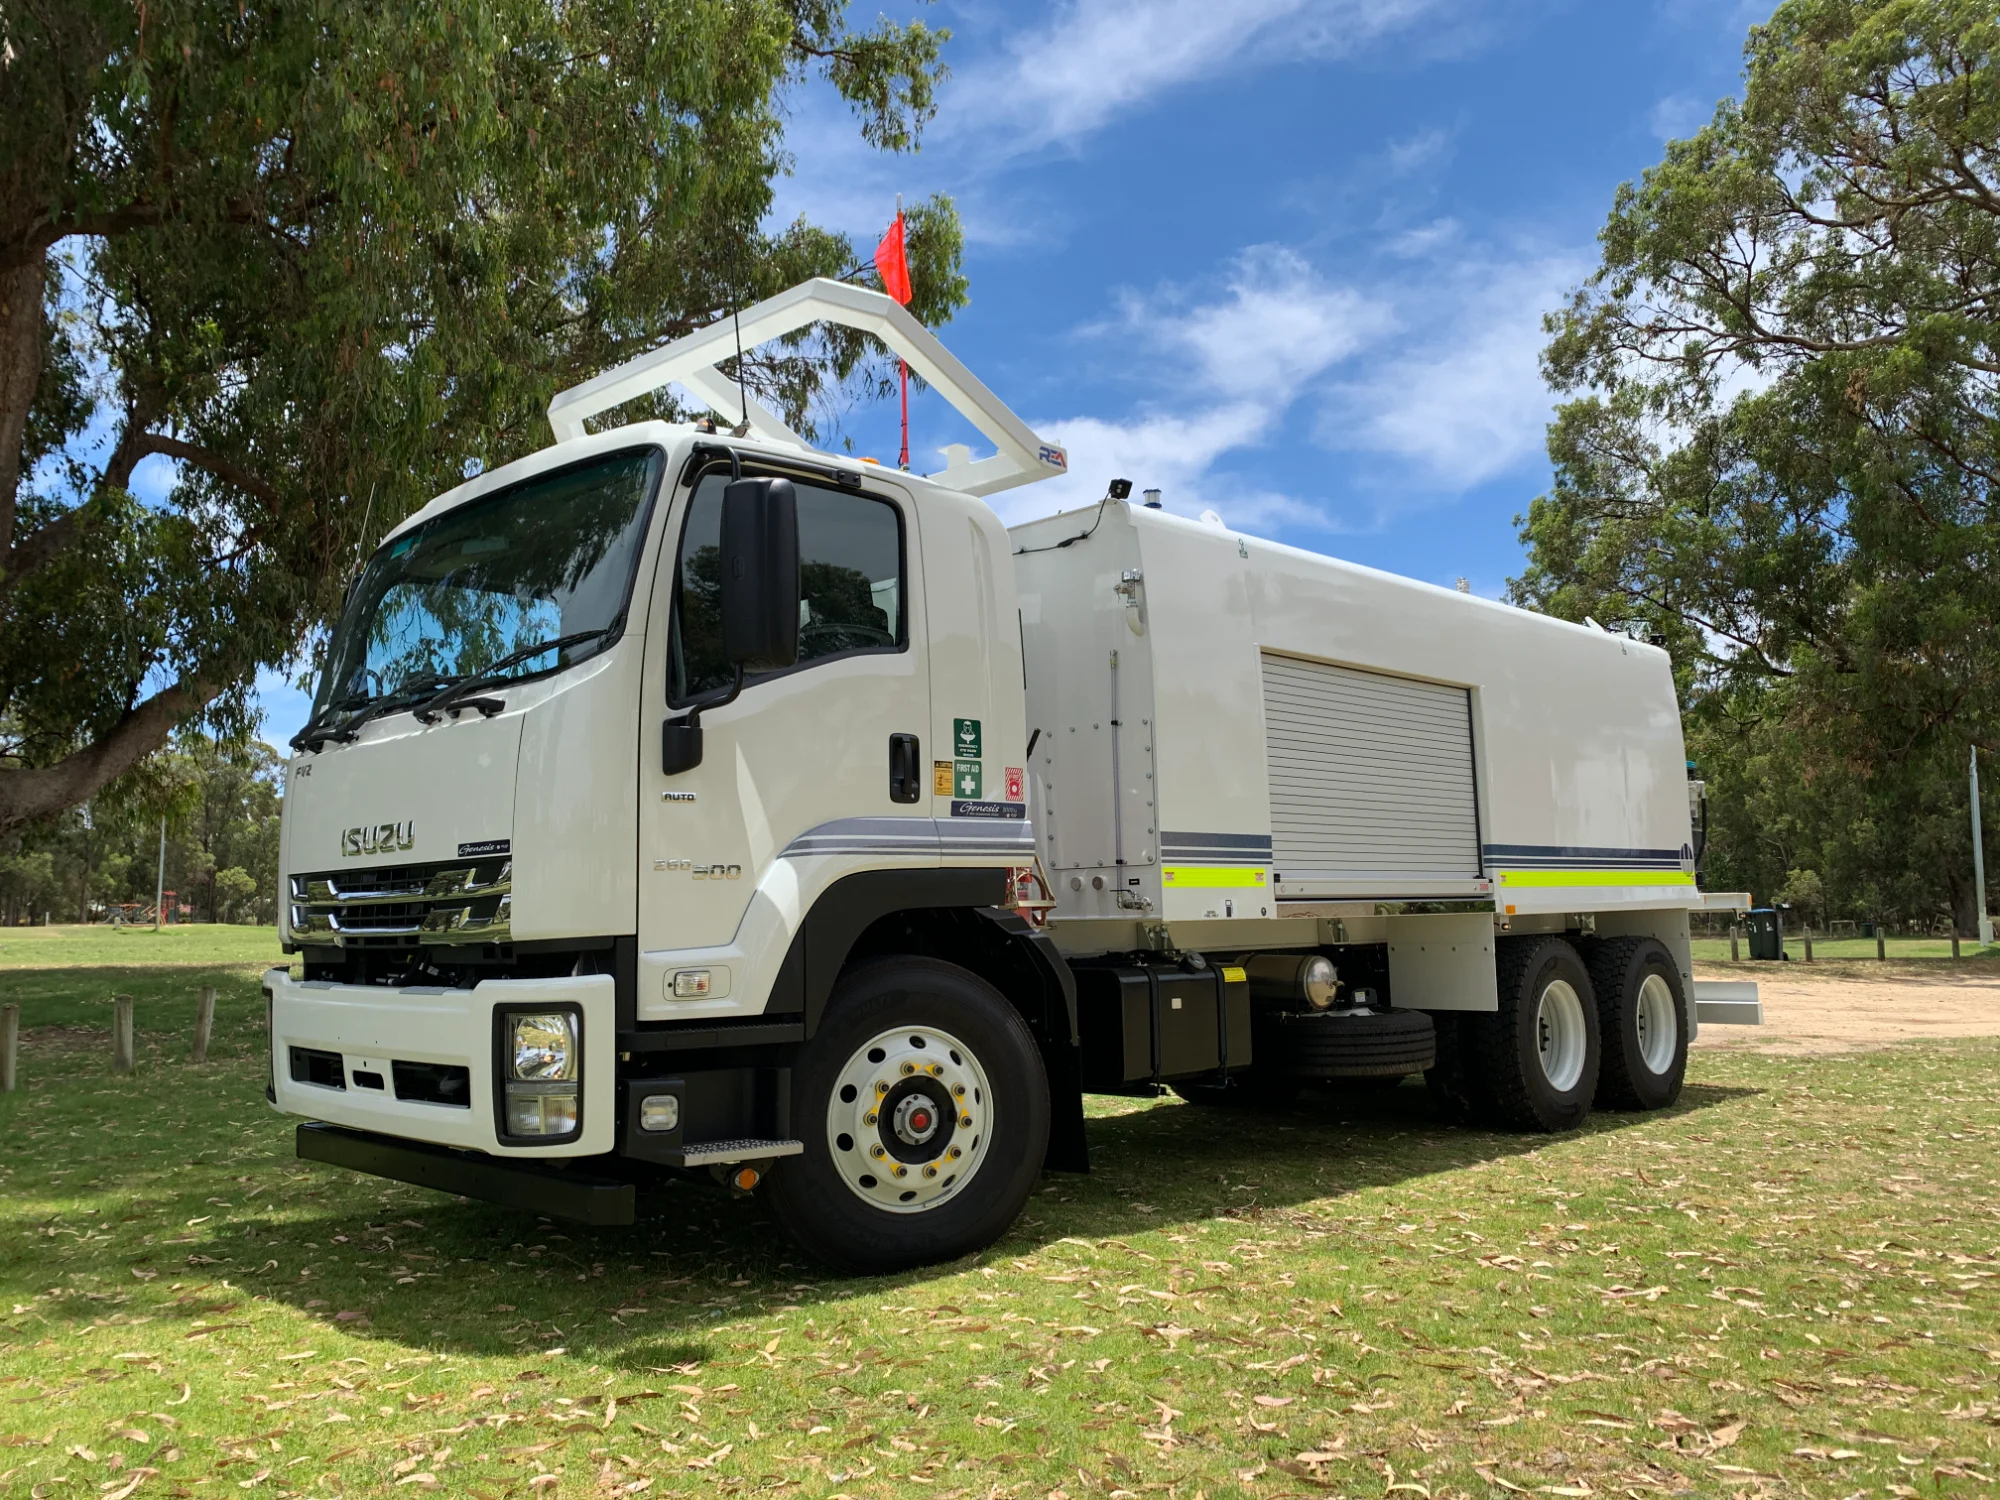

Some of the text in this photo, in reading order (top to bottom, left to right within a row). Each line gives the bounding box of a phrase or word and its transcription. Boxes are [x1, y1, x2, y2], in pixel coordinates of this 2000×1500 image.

[956, 763, 980, 773] FIRST AID
[664, 793, 695, 801] AUTO
[959, 802, 1000, 816] Genesis
[341, 820, 416, 857] ISUZU
[458, 843, 495, 855] Genesis
[653, 859, 742, 880] 260 300
